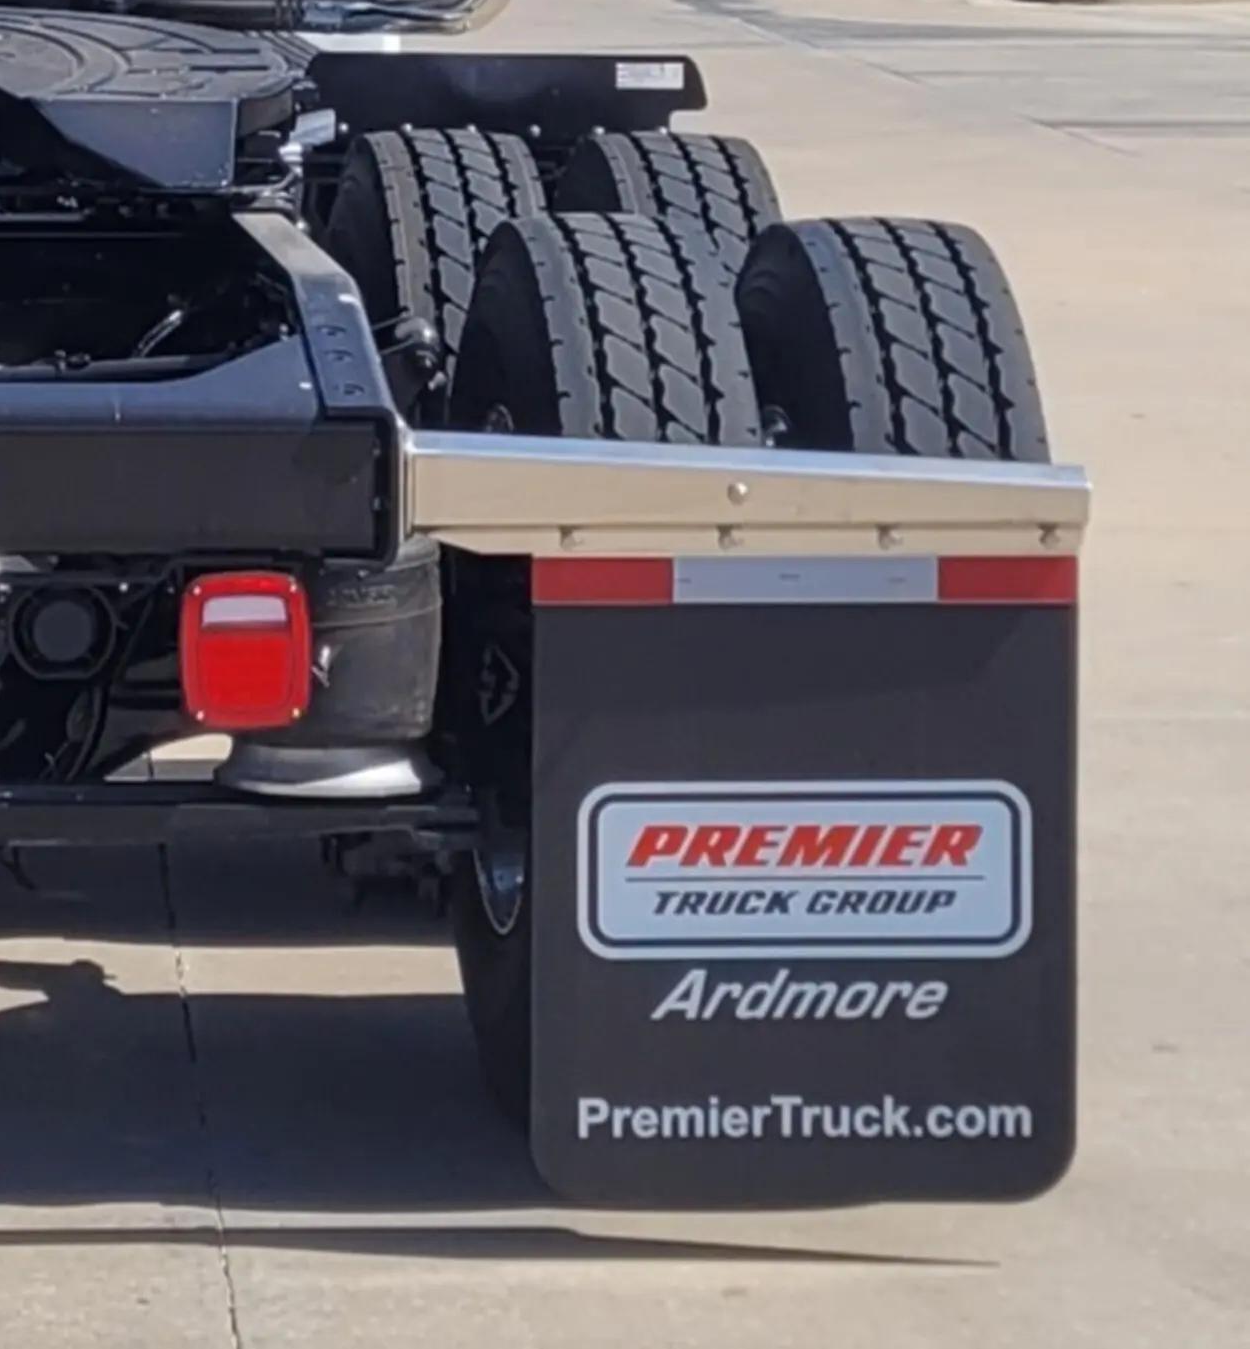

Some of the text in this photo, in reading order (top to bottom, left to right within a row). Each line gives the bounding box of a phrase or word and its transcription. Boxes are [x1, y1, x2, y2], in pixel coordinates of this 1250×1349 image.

[625, 824, 985, 868] PREMIER
[653, 889, 957, 915] TRUCK GROUP
[650, 968, 949, 1021] Ardmore
[576, 1094, 1033, 1140] PremierTruck.com
